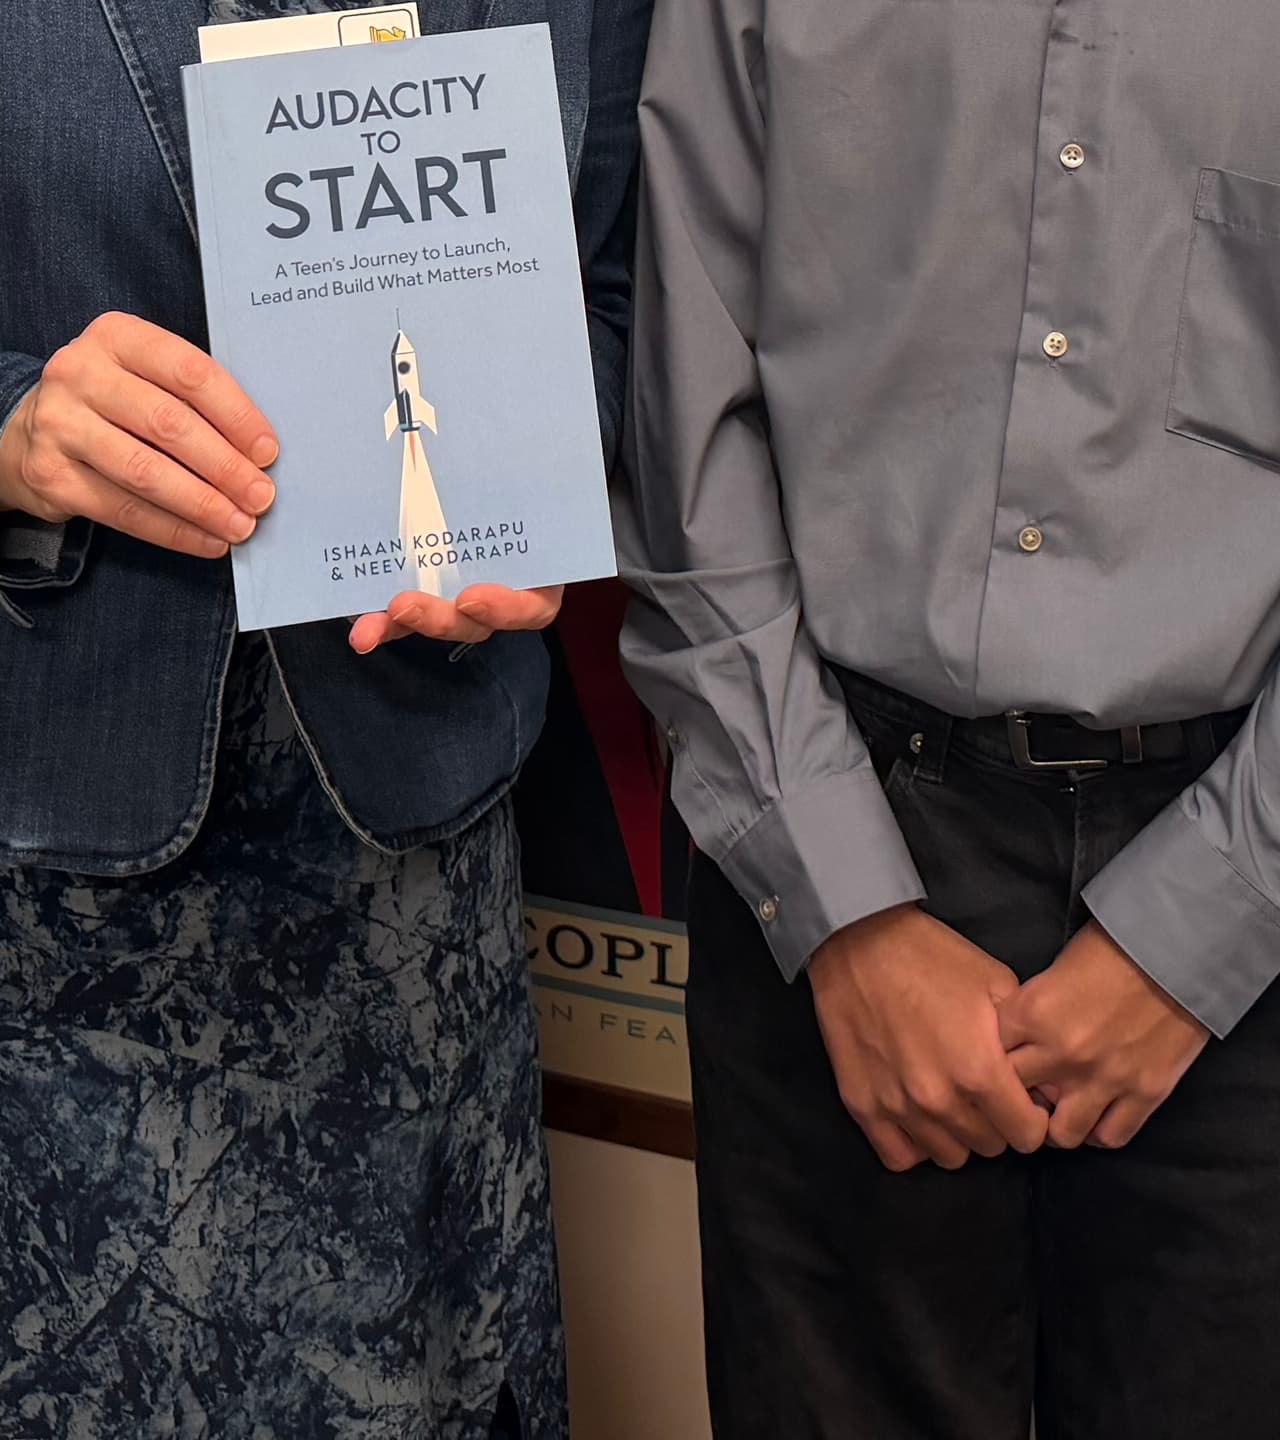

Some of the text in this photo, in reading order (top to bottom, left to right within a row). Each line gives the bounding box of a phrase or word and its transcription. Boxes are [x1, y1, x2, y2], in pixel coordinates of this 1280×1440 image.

[265, 73, 486, 134] AUDACITY
[360, 130, 401, 155] TO
[264, 148, 507, 239] START
[275, 237, 510, 279] A Teen's Journey to Launch,
[251, 257, 540, 306] Lead and Build What Matters Most
[324, 520, 524, 563] ISHAAN KODARAPU
[331, 540, 529, 581] & NEEV KODARAPU
